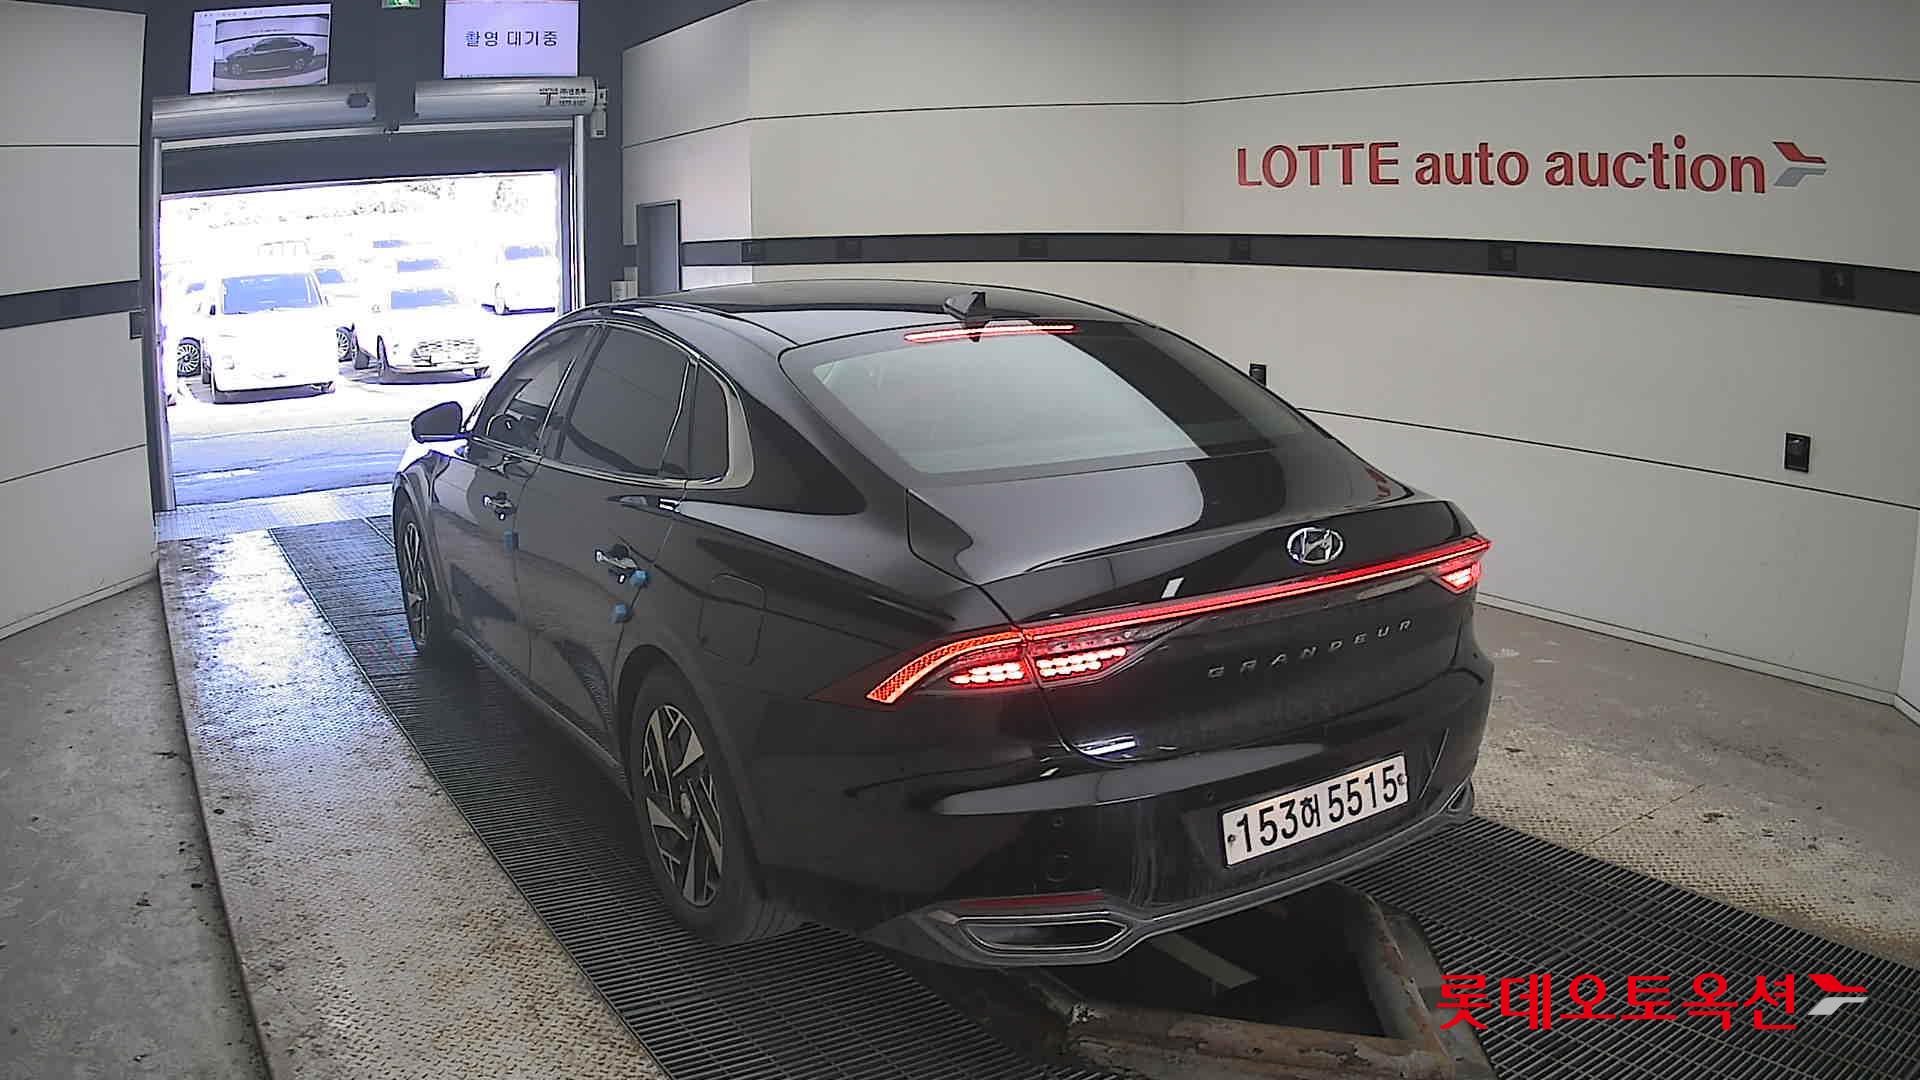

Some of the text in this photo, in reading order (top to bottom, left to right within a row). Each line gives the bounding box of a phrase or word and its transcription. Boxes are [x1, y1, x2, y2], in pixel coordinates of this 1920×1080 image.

[464, 30, 558, 47] 촬영 대기중
[1237, 134, 1766, 194] LOTTE auto auction
[1207, 619, 1412, 679] GRANDEUR
